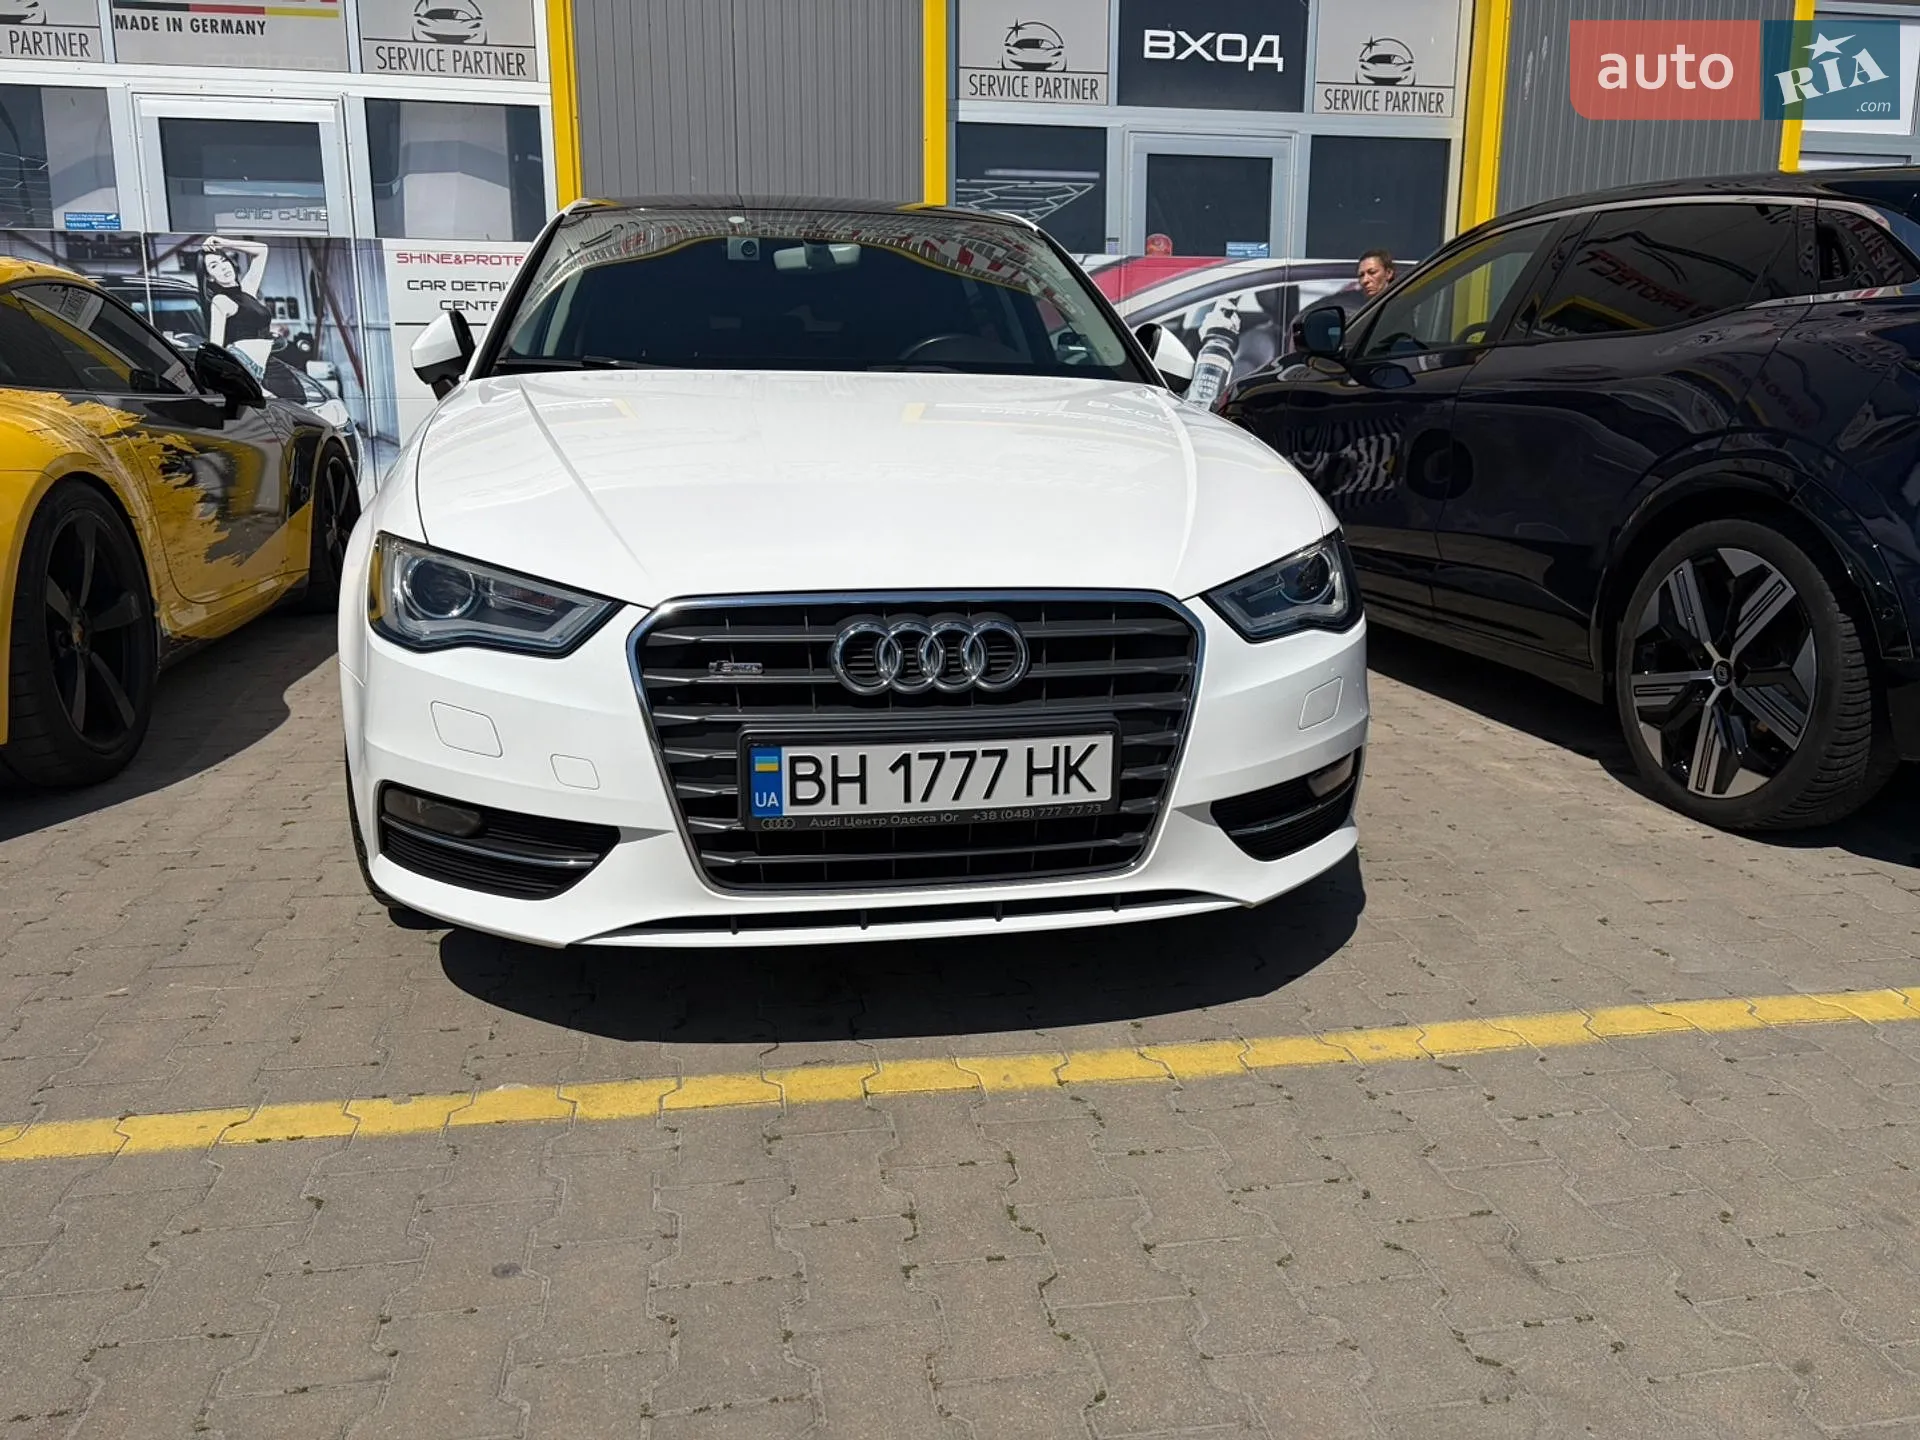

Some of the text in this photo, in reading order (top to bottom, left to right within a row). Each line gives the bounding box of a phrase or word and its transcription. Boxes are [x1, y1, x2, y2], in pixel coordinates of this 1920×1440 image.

[115, 14, 266, 35] MADE IN GERMANY
[9, 30, 91, 57] PARTNER
[1144, 29, 1283, 72] ВХОД
[376, 46, 527, 76] SERVICE PARTNER
[969, 73, 1098, 100] SERVICE PARTNER
[1324, 88, 1445, 114] SERVICE PARTNER
[407, 279, 508, 292] CAR DETAI
[789, 744, 1099, 806] BH 1777 HK
[755, 791, 779, 807] UA
[808, 816, 841, 828] Audi
[844, 816, 887, 828] Центр
[890, 814, 937, 826] Одесса
[972, 810, 998, 821] +38
[1001, 808, 1035, 820] (048)
[1038, 806, 1062, 818] 777
